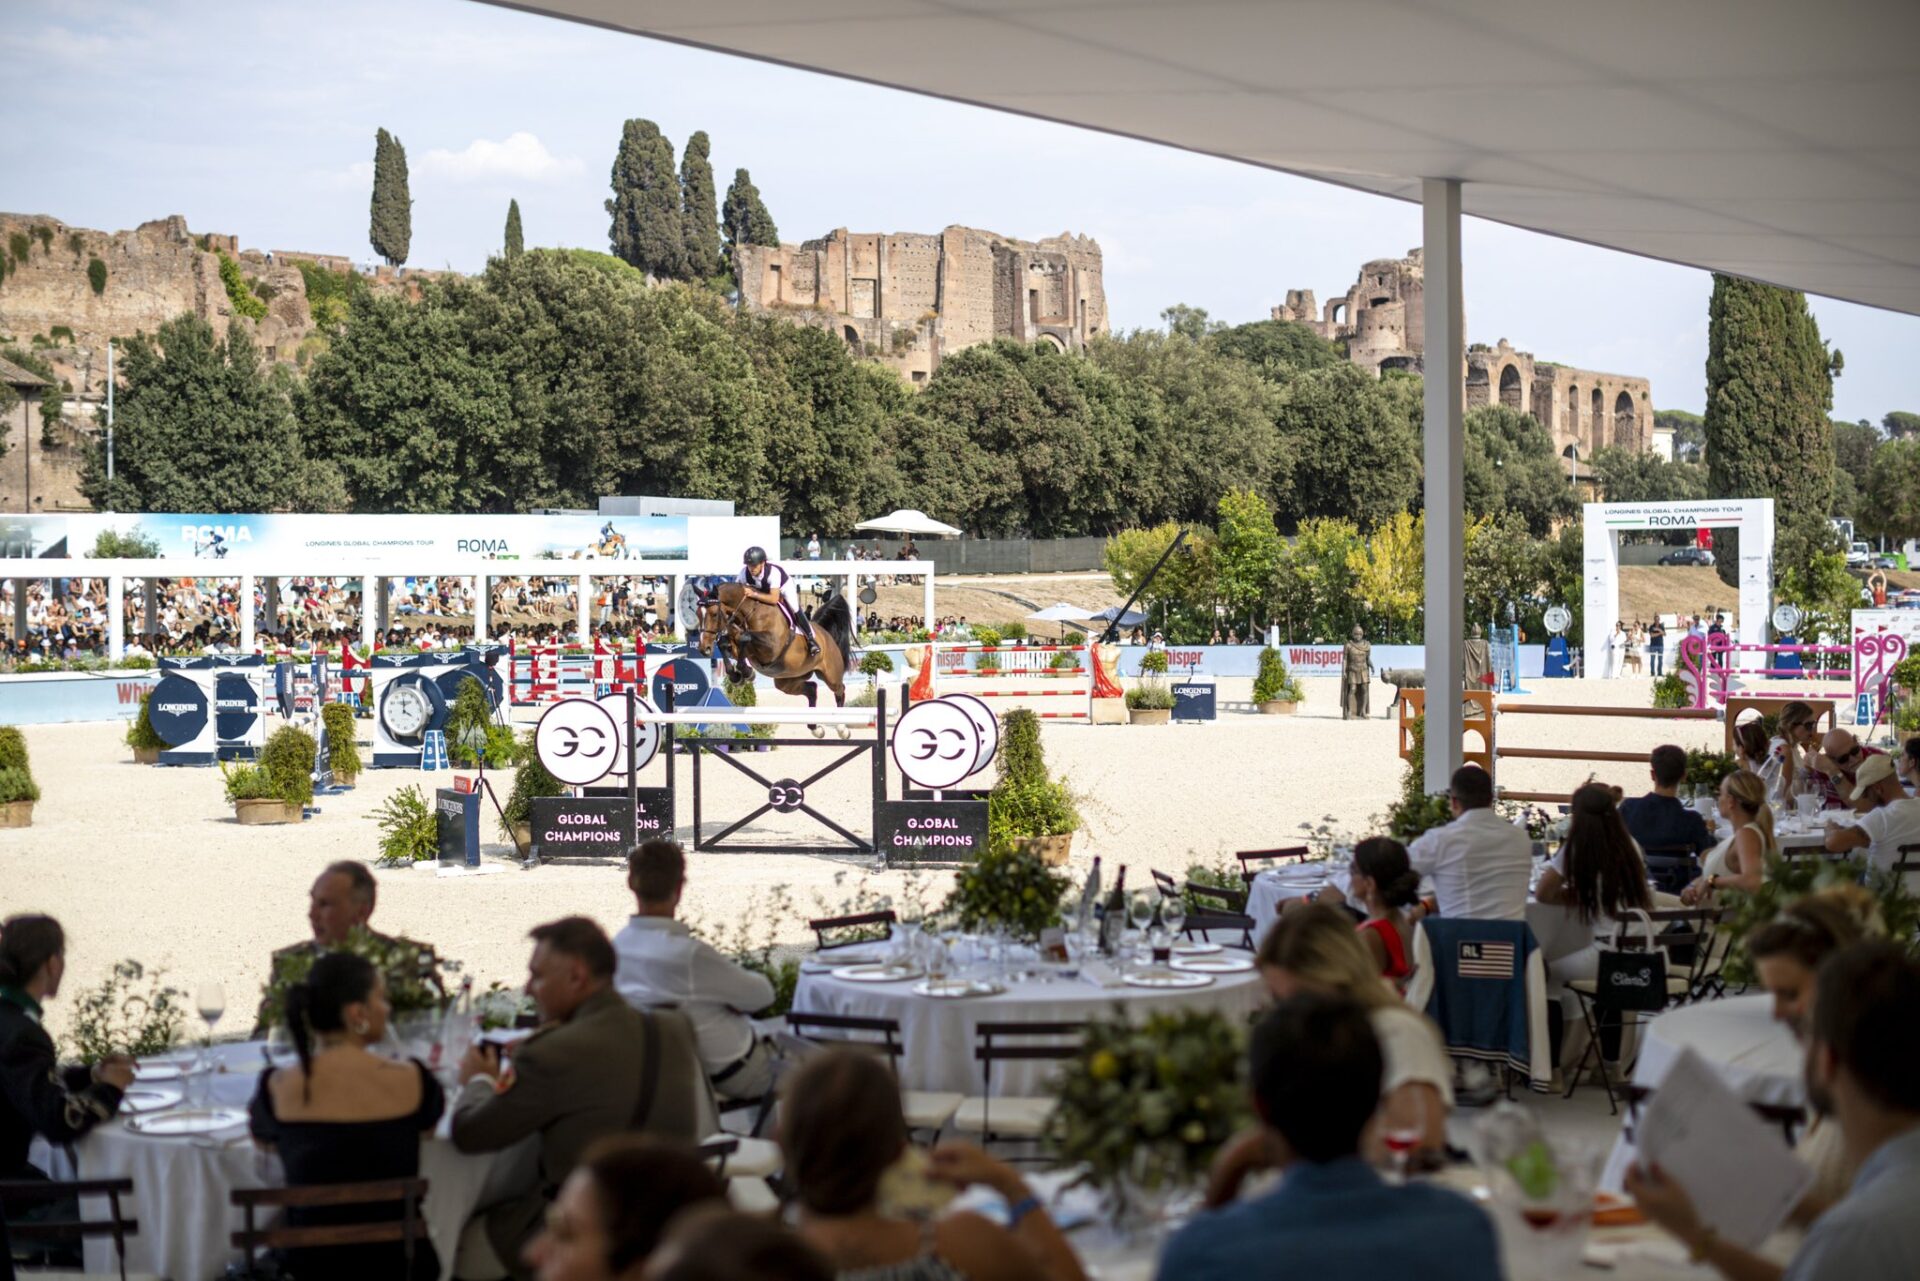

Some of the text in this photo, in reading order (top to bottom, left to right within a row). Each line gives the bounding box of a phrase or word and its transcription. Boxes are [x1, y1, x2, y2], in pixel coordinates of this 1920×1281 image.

[1649, 516, 1697, 526] ROMA
[457, 539, 509, 552] ROMA
[937, 653, 966, 669] hisper
[1165, 649, 1204, 668] hisper
[1289, 648, 1344, 668] Whisper
[158, 703, 198, 711] LONGINES
[552, 726, 606, 758] GC
[909, 728, 966, 760] GC
[557, 814, 607, 825] GLOBAL
[544, 831, 621, 842] CHAMPIONS
[893, 835, 973, 846] CHAMPIONS
[1462, 944, 1479, 958] RL
